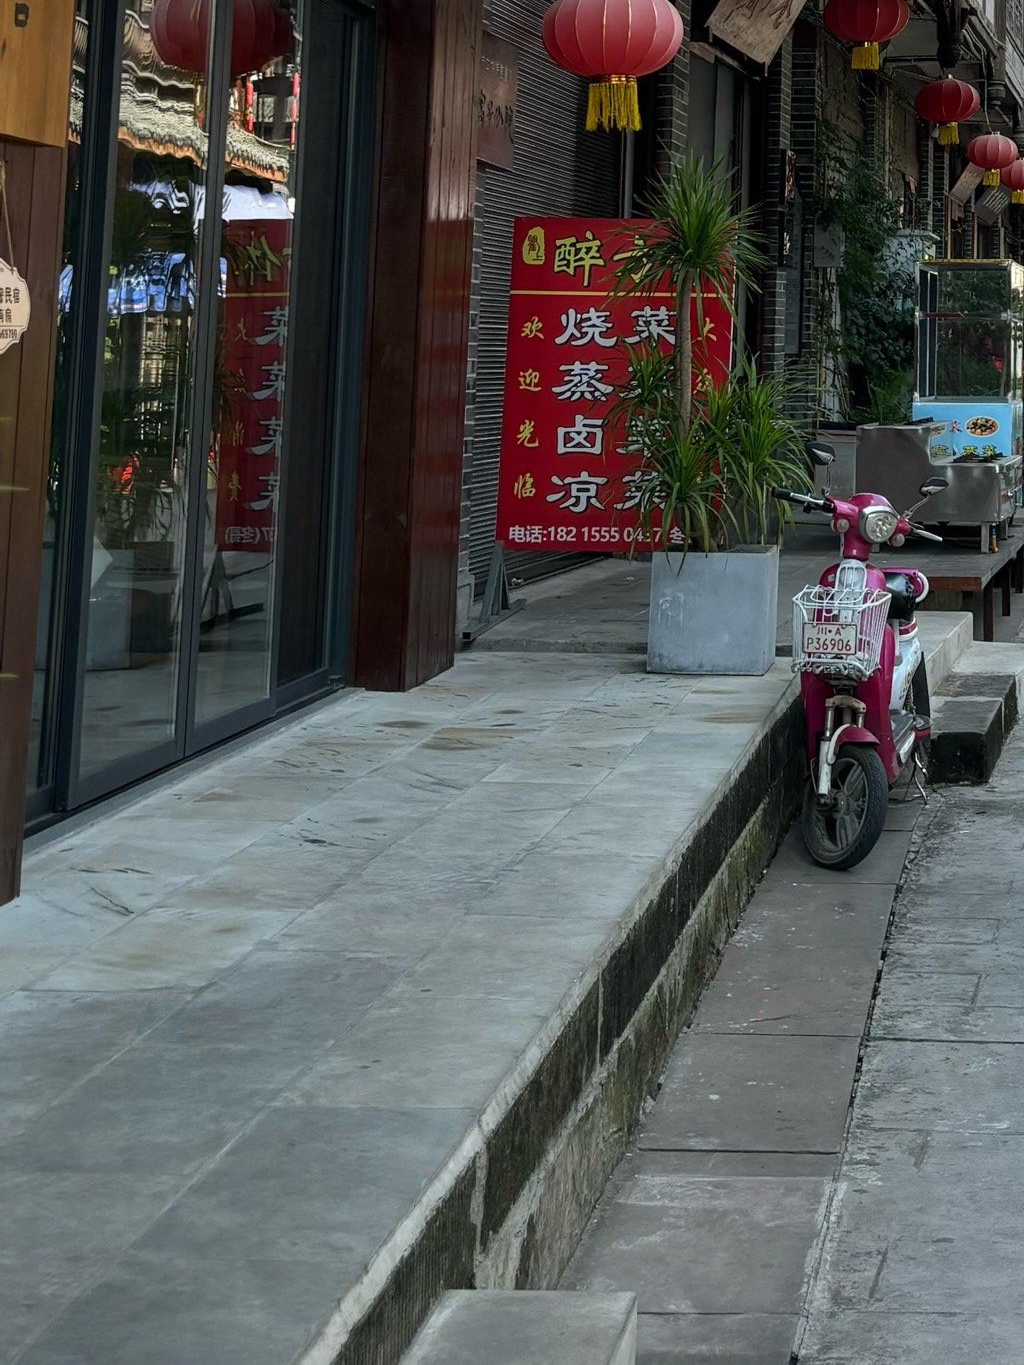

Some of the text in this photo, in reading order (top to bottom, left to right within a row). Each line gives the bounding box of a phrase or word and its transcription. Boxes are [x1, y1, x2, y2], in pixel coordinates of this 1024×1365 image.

[555, 305, 677, 347] 烧菜
[582, 526, 620, 543] 1555
[806, 637, 852, 652] P36906
